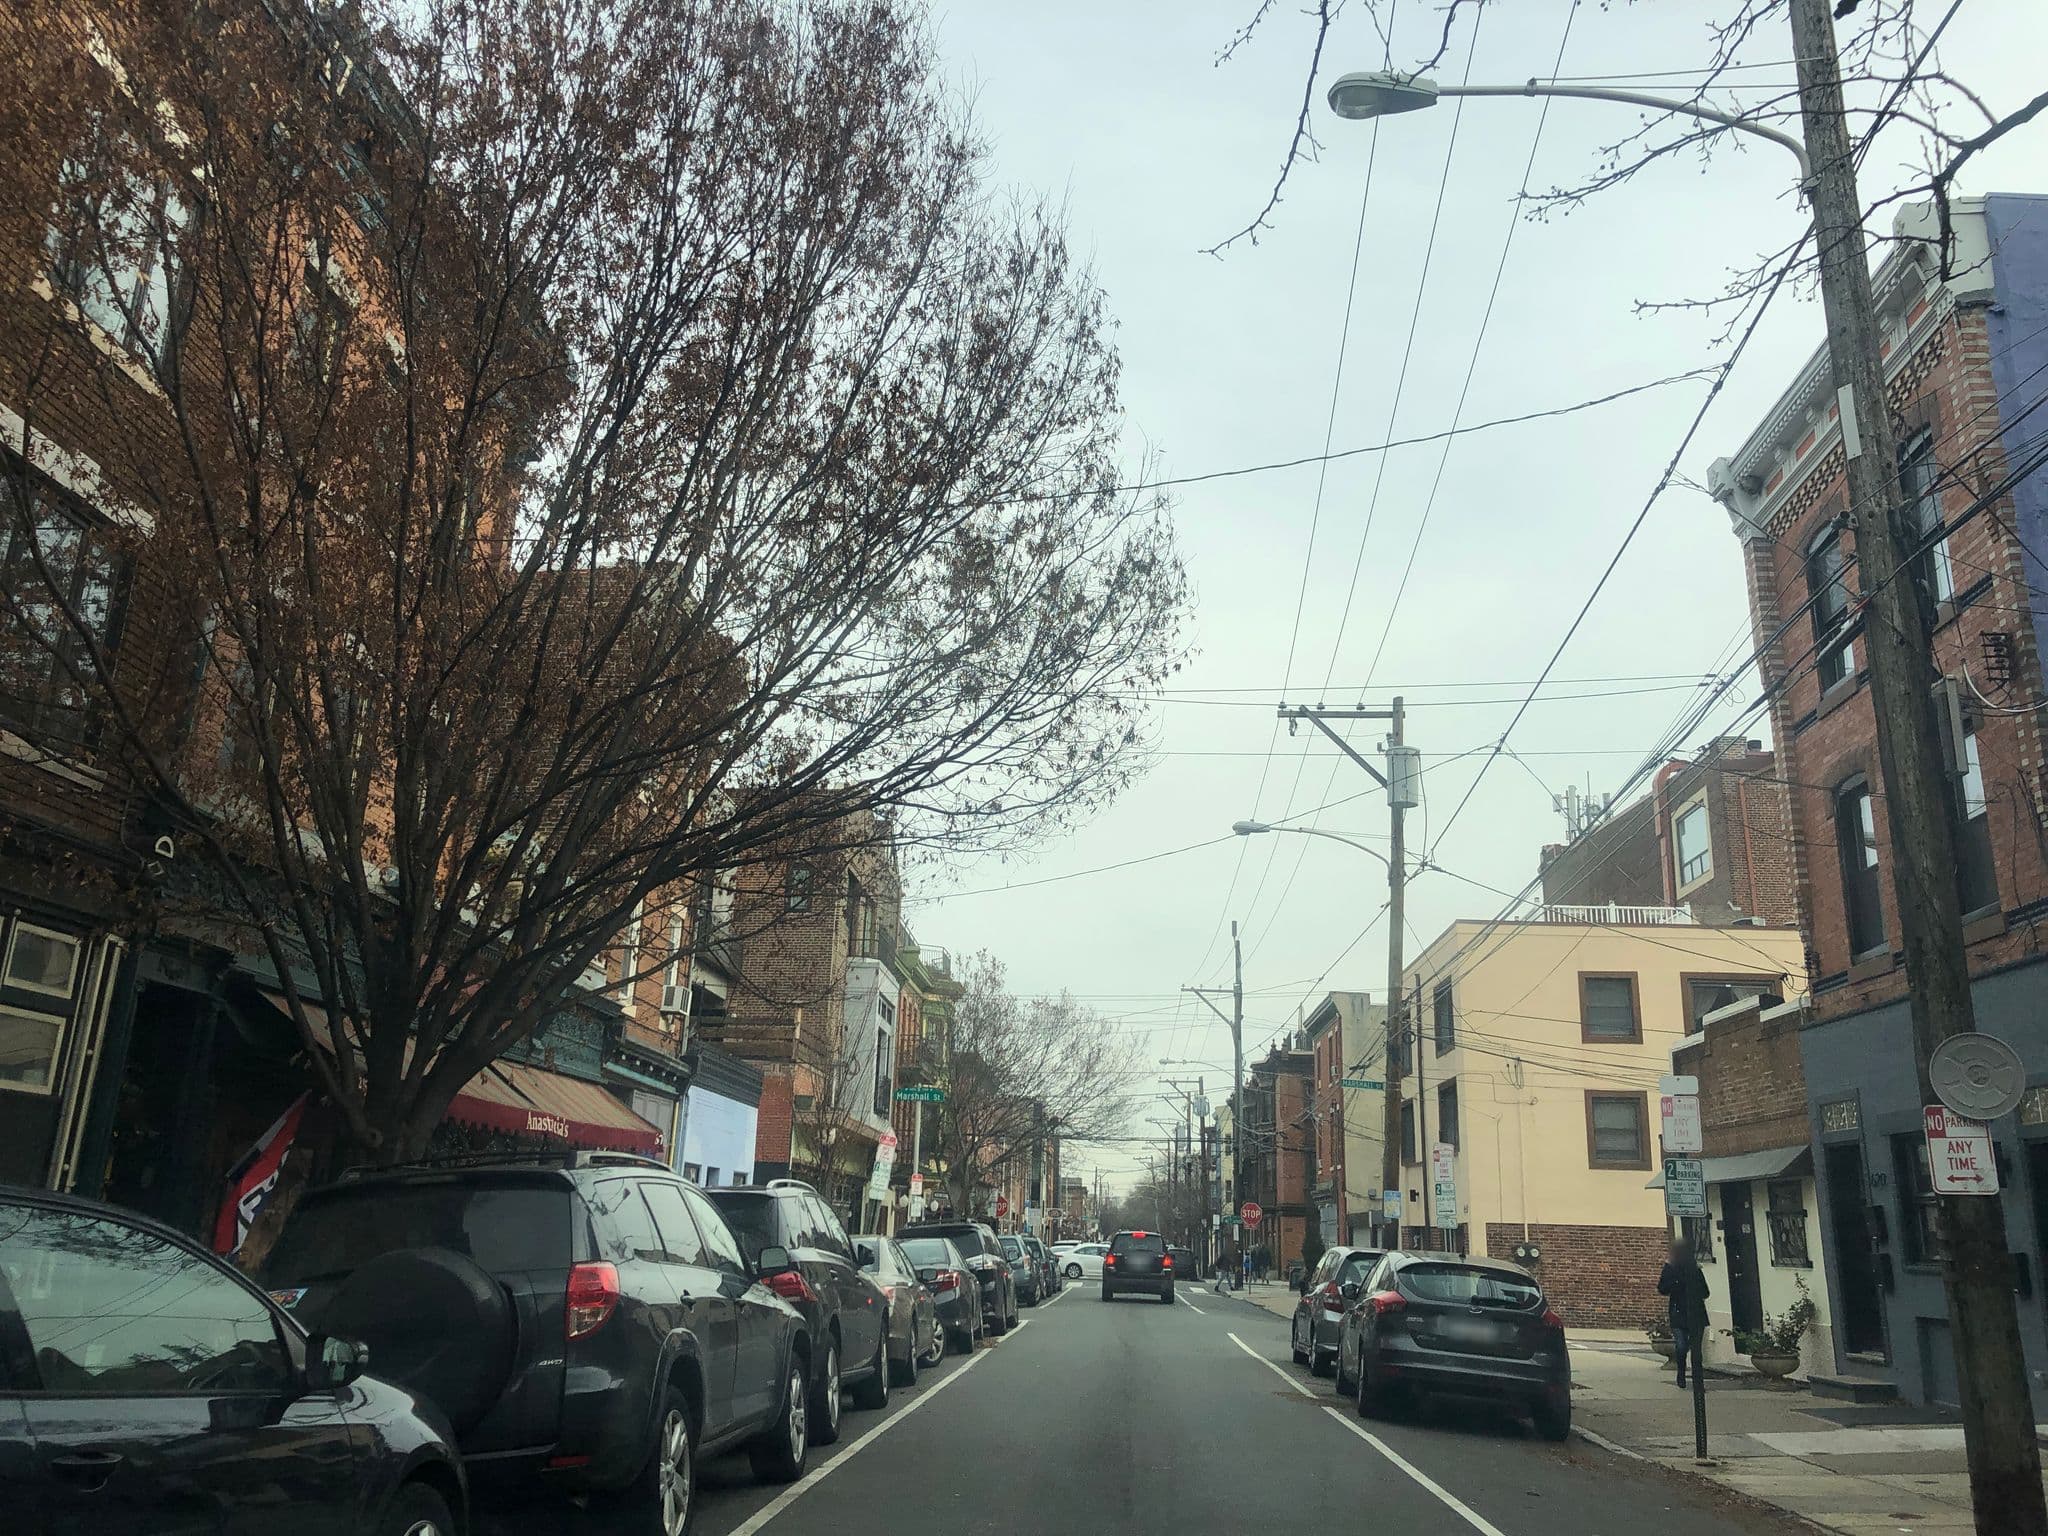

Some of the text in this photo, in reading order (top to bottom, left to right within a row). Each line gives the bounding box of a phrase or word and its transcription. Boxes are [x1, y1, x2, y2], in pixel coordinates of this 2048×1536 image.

[1343, 1080, 1373, 1088] MARSHALL
[896, 1091, 941, 1101] Marshall St
[1662, 1102, 1672, 1113] NO
[1927, 1114, 1943, 1131] NO
[1947, 1140, 1973, 1154] ANY
[1667, 1162, 1675, 1177] 2
[1947, 1156, 1979, 1171] TIME
[1242, 1209, 1261, 1219] STOP
